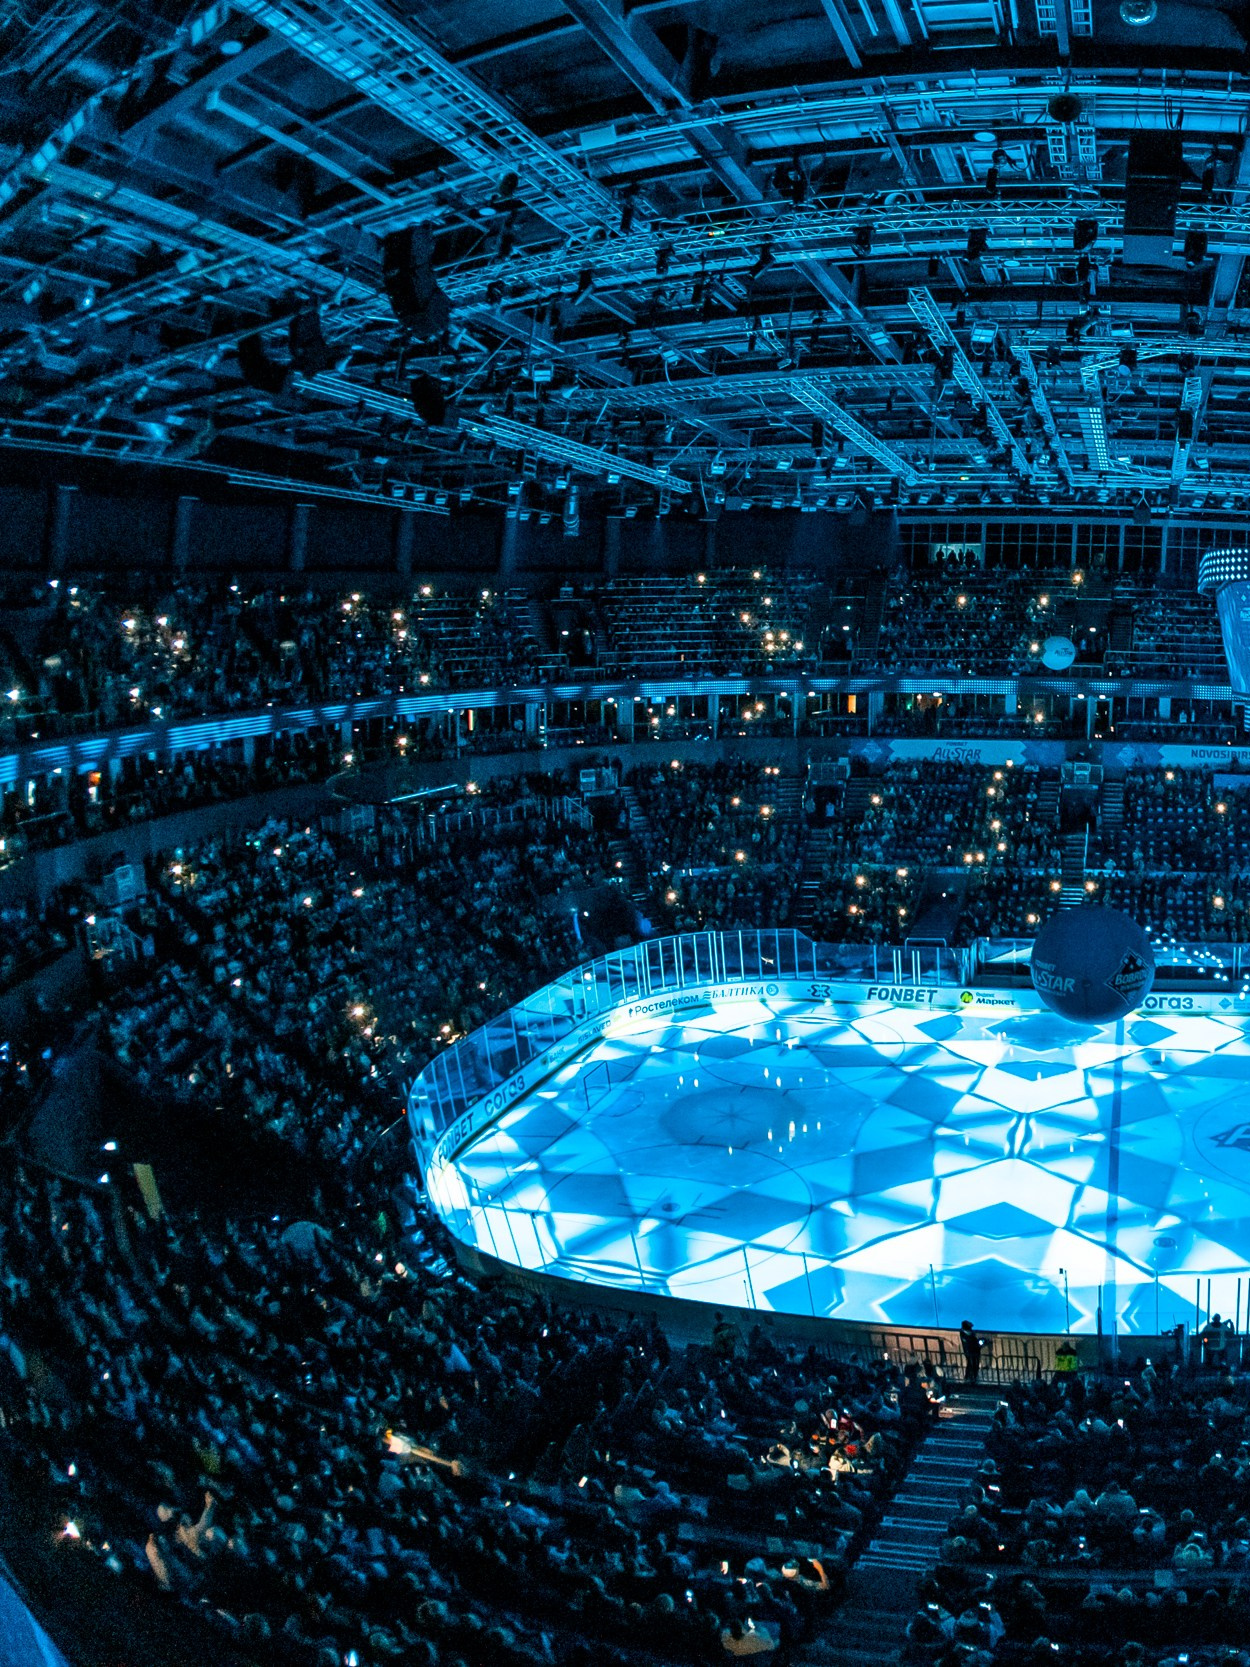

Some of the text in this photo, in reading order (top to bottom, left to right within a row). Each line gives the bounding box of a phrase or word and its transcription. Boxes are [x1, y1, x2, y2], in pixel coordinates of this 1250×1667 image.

[712, 985, 764, 999] БАЛТИКА
[867, 987, 938, 1003] FONBET
[634, 994, 699, 1014] Ростелеком
[976, 998, 1015, 1006] Маркет
[1141, 996, 1193, 1009] огаз
